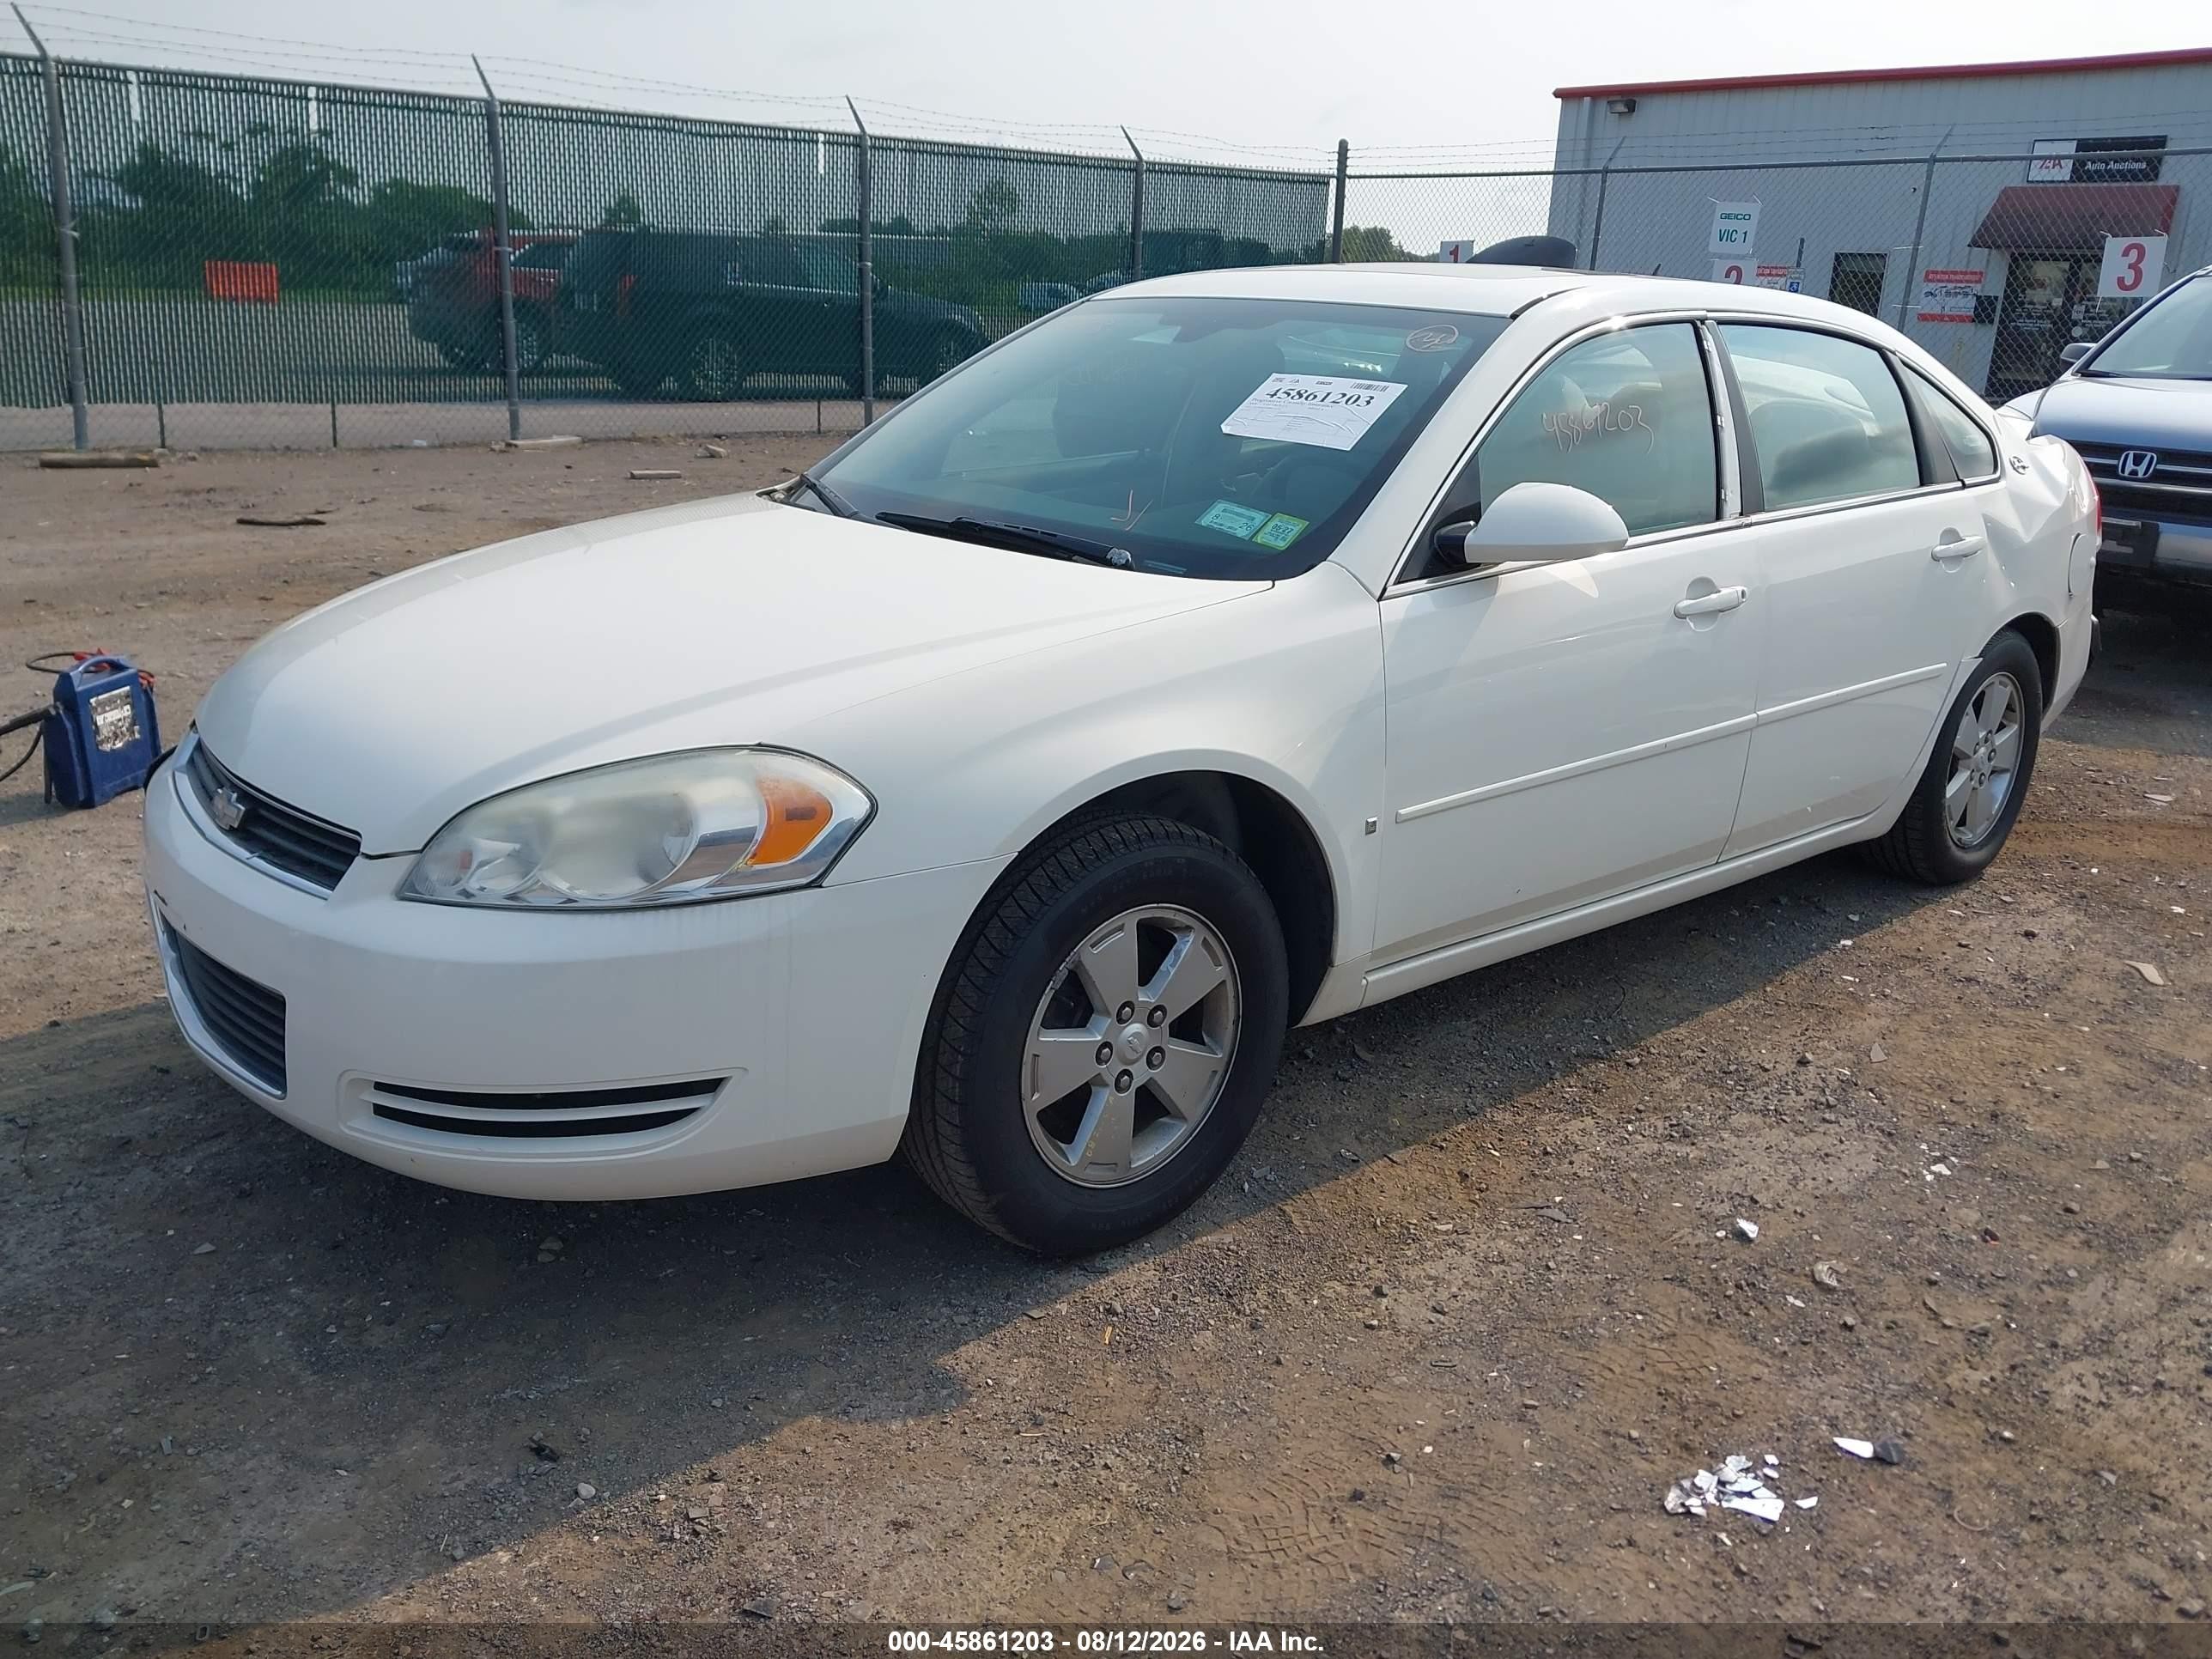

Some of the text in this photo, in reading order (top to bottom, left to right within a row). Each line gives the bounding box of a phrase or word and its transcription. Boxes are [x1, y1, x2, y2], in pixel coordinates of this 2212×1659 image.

[2085, 160, 2147, 170] Auto Auctions
[1720, 212, 1752, 221] GEICO
[1718, 228, 1748, 244] VIC 1
[1449, 244, 1459, 263] 1
[2117, 242, 2146, 292] 3
[1265, 386, 1375, 408] 45861203
